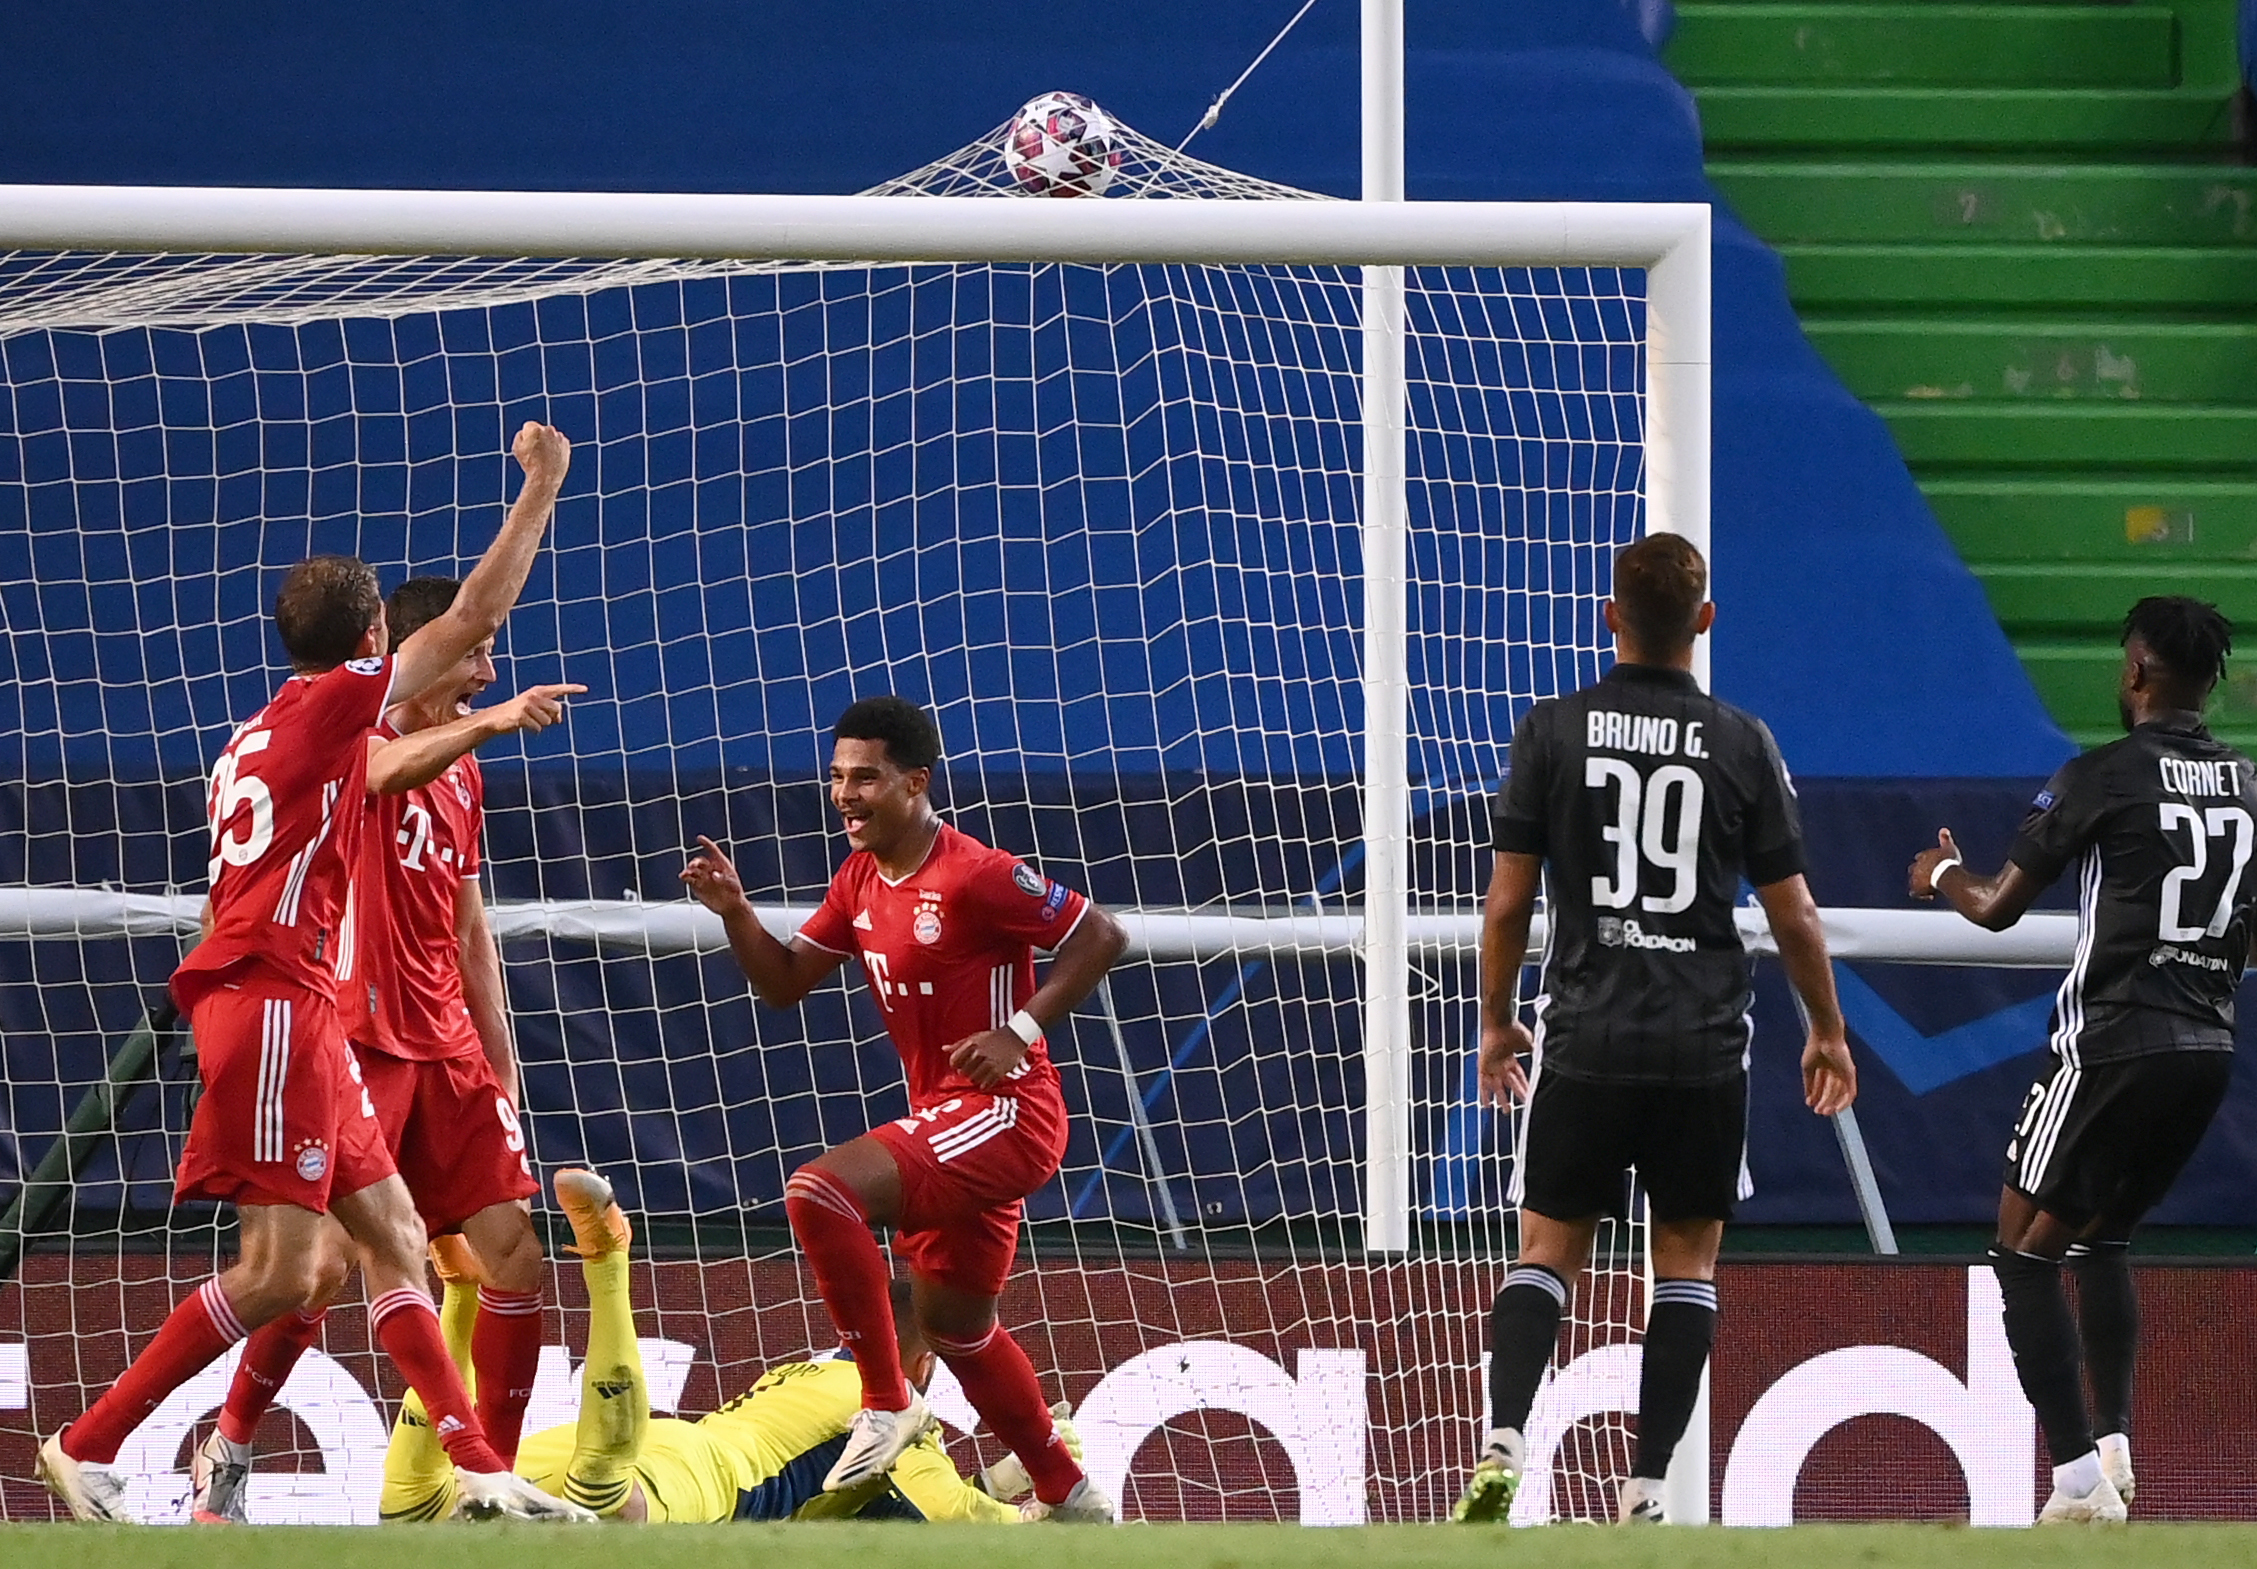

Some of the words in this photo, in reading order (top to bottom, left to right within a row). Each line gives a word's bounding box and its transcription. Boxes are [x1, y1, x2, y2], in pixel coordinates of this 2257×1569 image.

[1587, 710, 1678, 756] BRUNO
[1684, 721, 1710, 760] G.
[2159, 757, 2240, 797] CORNET
[1585, 757, 1705, 914] 39
[2158, 802, 2255, 942] 27
[495, 1097, 525, 1153] 9
